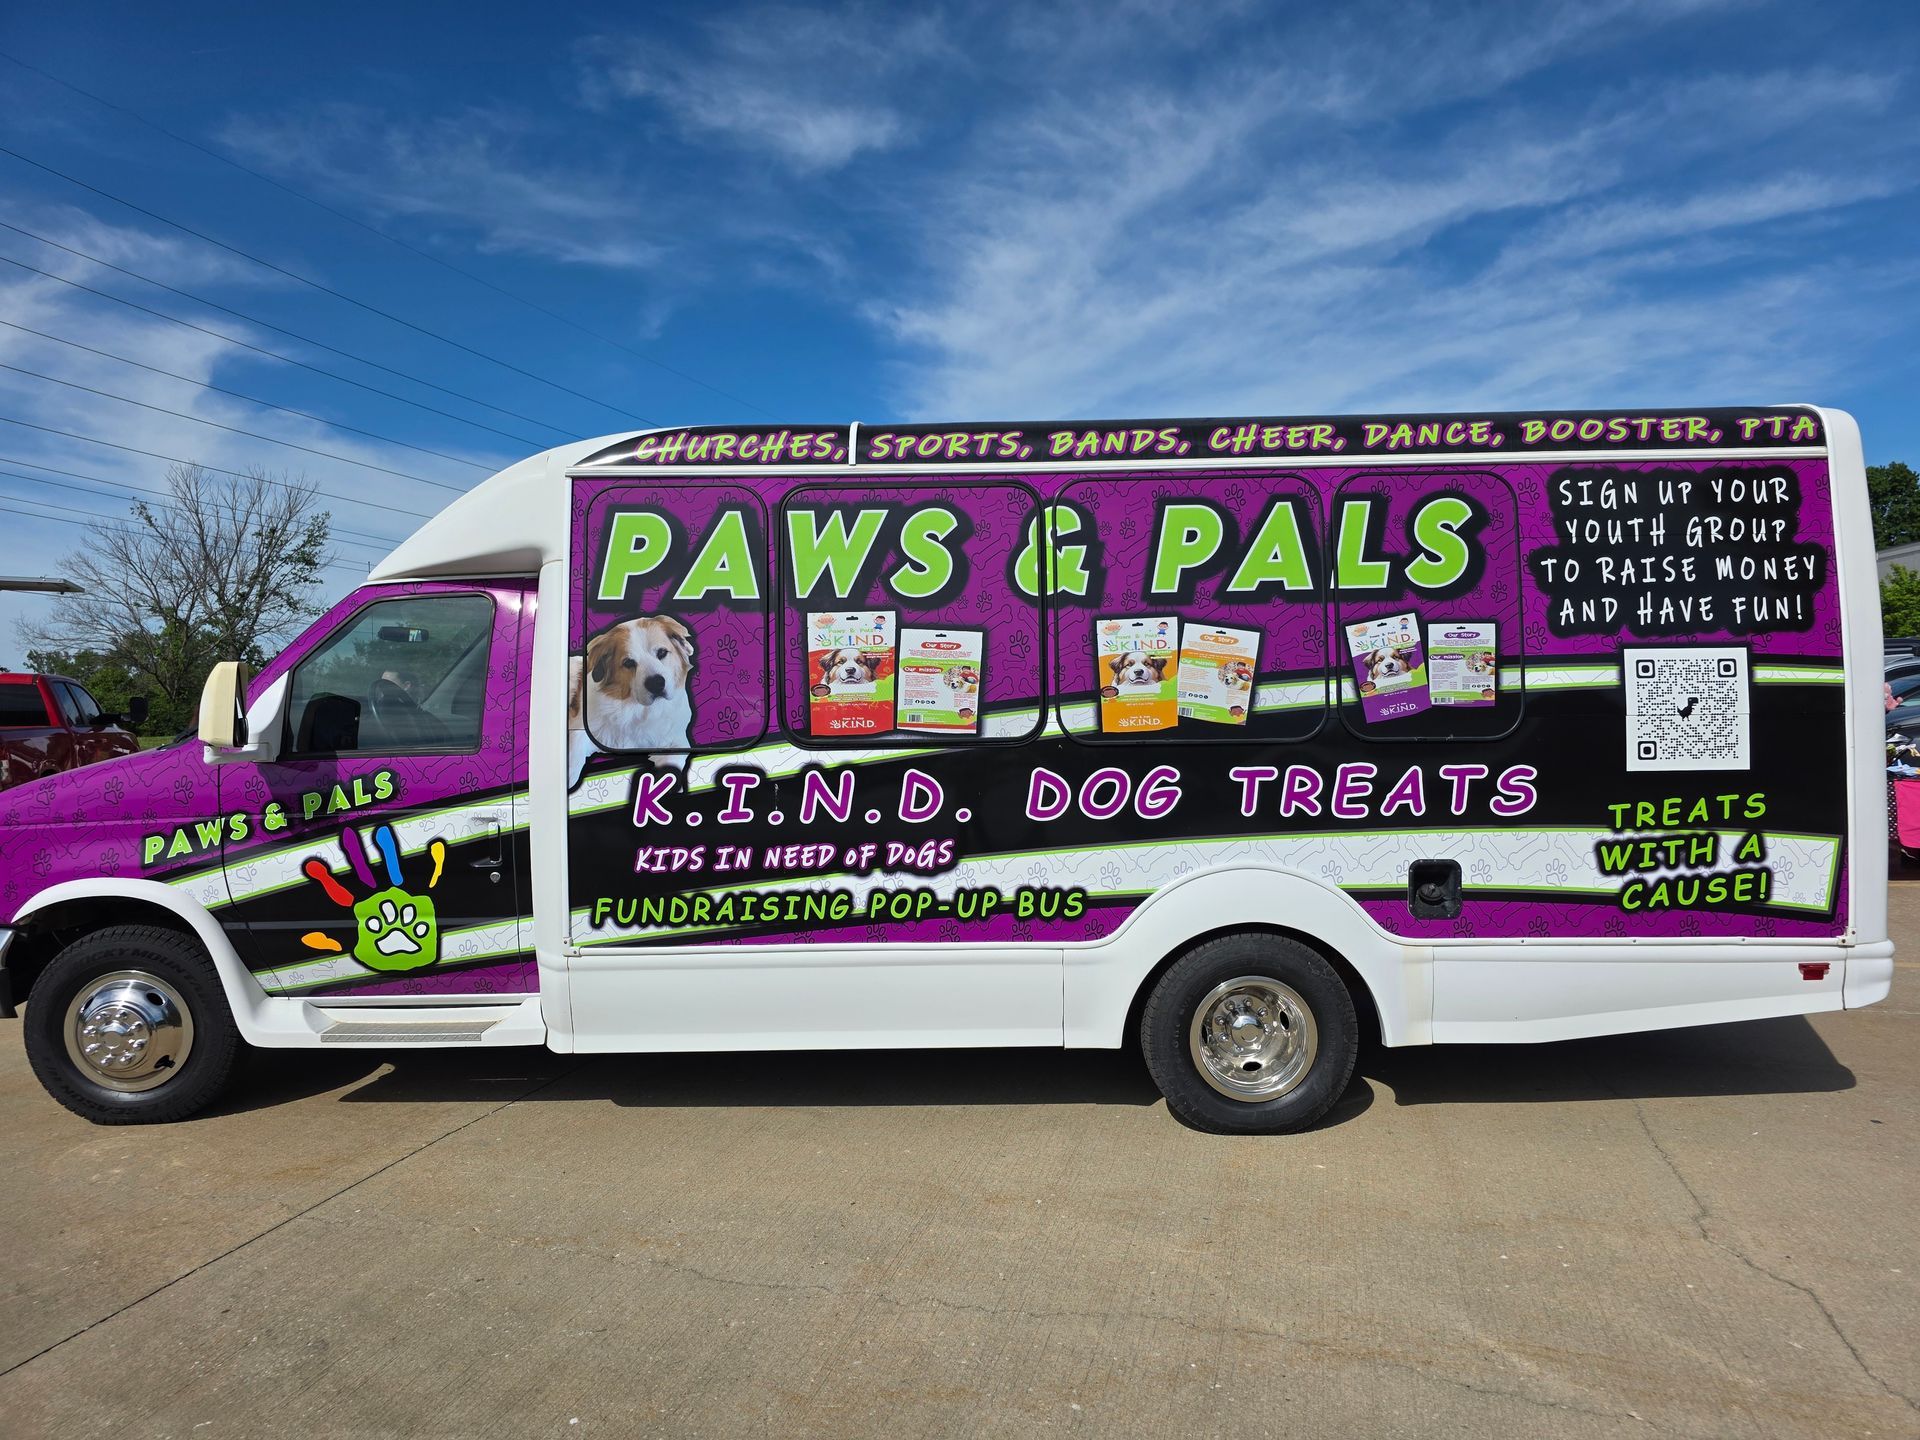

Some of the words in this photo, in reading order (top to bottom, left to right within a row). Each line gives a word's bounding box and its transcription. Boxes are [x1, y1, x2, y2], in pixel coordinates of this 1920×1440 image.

[637, 432, 845, 462] CHURCHES,
[870, 432, 1032, 458] SPORTS,
[1050, 427, 1191, 456] BANDS,
[1210, 424, 1346, 452] CHEER,
[1366, 421, 1506, 447] DANCE,
[1522, 416, 1721, 443] BOOSTER,
[1741, 416, 1818, 439] PTA
[1559, 479, 1638, 509] SIGN
[1658, 481, 1692, 505] UP
[1711, 477, 1789, 503] YOUR
[597, 508, 957, 599] PAWS
[1015, 505, 1090, 596] &
[1150, 497, 1473, 593] PALS
[1565, 513, 1666, 546] YOUTH
[1686, 516, 1786, 547] GROUP
[1540, 558, 1580, 583] TO
[1596, 556, 1696, 585] RAISE
[1715, 555, 1815, 581] MONEY
[1559, 597, 1618, 626] AND
[1637, 592, 1714, 626] HAVE
[1733, 596, 1802, 623] FUN!
[835, 634, 887, 646] K.I.N.D.
[1121, 640, 1170, 651] K.I.N.D.
[632, 768, 973, 828] K.I.N.D.
[1025, 766, 1182, 821] DOG
[1230, 762, 1538, 820] TREATS
[1608, 792, 1767, 829] TREATS
[144, 813, 248, 865] PAWS
[264, 802, 287, 831] &
[303, 771, 393, 821] PALS
[635, 848, 705, 871] KIDS
[715, 848, 752, 869] IN
[765, 846, 834, 868] NEED
[1601, 836, 1714, 872] WITH
[1739, 833, 1761, 860] A
[595, 893, 851, 925] FUNDRAISING
[869, 889, 998, 919] POP-UP
[1018, 890, 1085, 918] BUS
[1622, 871, 1768, 910] CAUSE!
